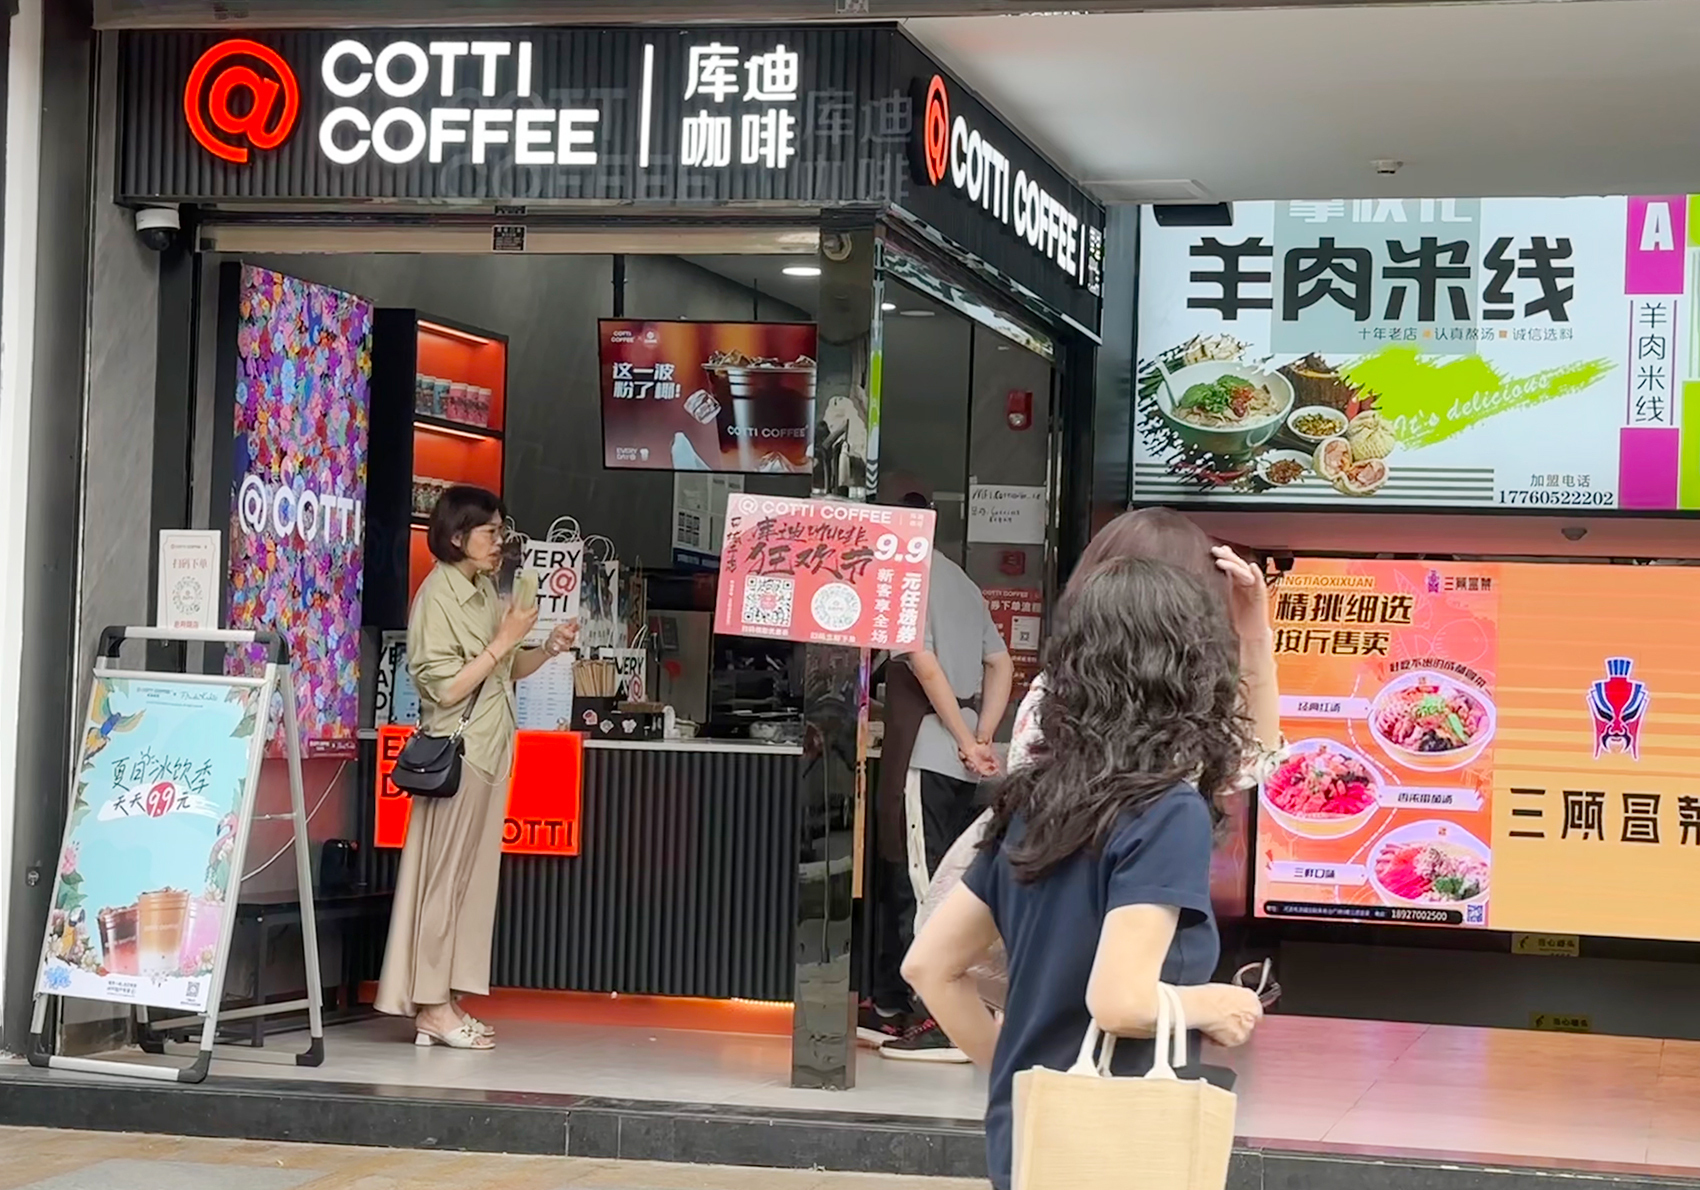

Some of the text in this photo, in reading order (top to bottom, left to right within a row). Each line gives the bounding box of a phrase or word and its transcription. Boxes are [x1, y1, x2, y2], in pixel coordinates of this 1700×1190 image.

[321, 40, 531, 97] COTTI
[684, 42, 798, 102] 库迪
[319, 106, 600, 165] COFFEE
[681, 108, 796, 169] 咖啡
[951, 115, 1010, 224] COTTI
[1013, 169, 1078, 276] COFFEE
[1640, 202, 1674, 250] A
[1186, 236, 1575, 322] 羊肉米线
[1358, 327, 1573, 341] 十年老店 认真熬汤 诚信选料
[612, 362, 675, 380] 这一波
[1635, 302, 1667, 422] 羊肉米线
[1393, 376, 1549, 437] It's delicious
[761, 428, 806, 438] COFFEE
[1530, 474, 1591, 488] 加盟电话
[1499, 490, 1613, 505] 17760522202
[273, 485, 361, 546] COTTI
[761, 502, 814, 518] COTTI
[820, 506, 892, 524] COFFEE
[753, 516, 869, 546] 库迪咖啡
[523, 549, 580, 568] VERY
[874, 533, 929, 563] 9.9
[745, 542, 875, 585] 狂欢节
[536, 594, 568, 613] TTI
[871, 568, 895, 644] 新客享全场
[1275, 593, 1413, 624] 精挑细选
[1274, 629, 1390, 656] 按斤售卖
[612, 656, 644, 675] VERY
[502, 818, 574, 847] OTTI
[1391, 909, 1448, 922] 18927002500
